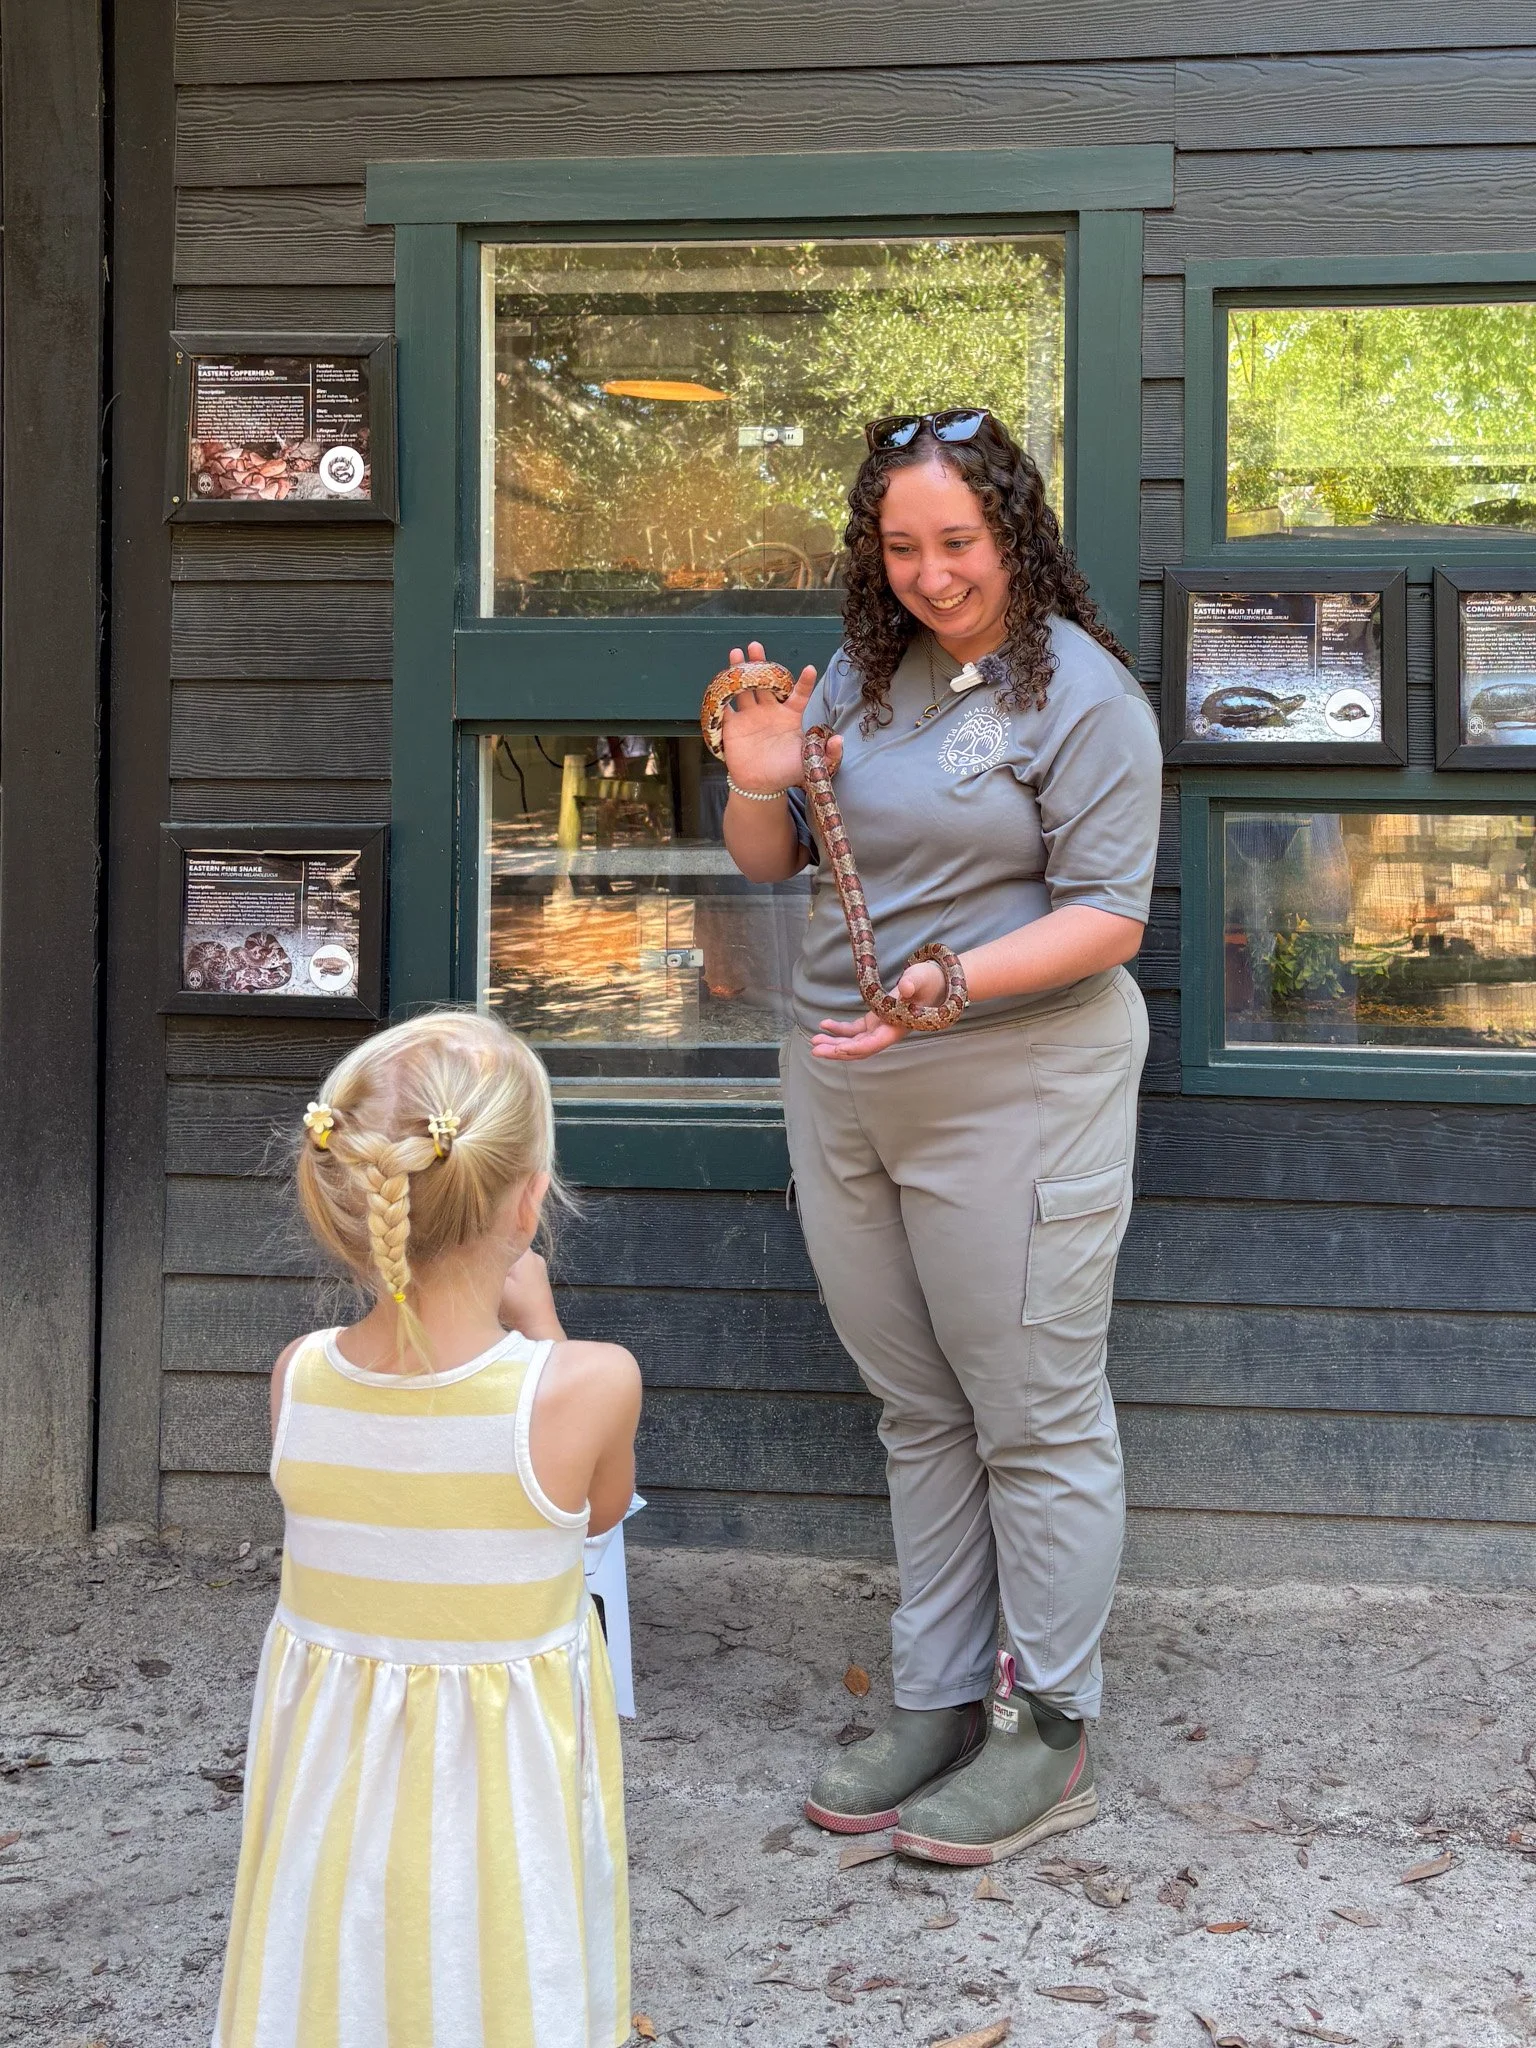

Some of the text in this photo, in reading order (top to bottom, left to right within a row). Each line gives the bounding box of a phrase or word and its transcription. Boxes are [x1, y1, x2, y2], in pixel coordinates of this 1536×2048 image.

[964, 706, 1011, 728] MAGNOLIA
[937, 728, 1008, 775] PLANTATION & GARDENS
